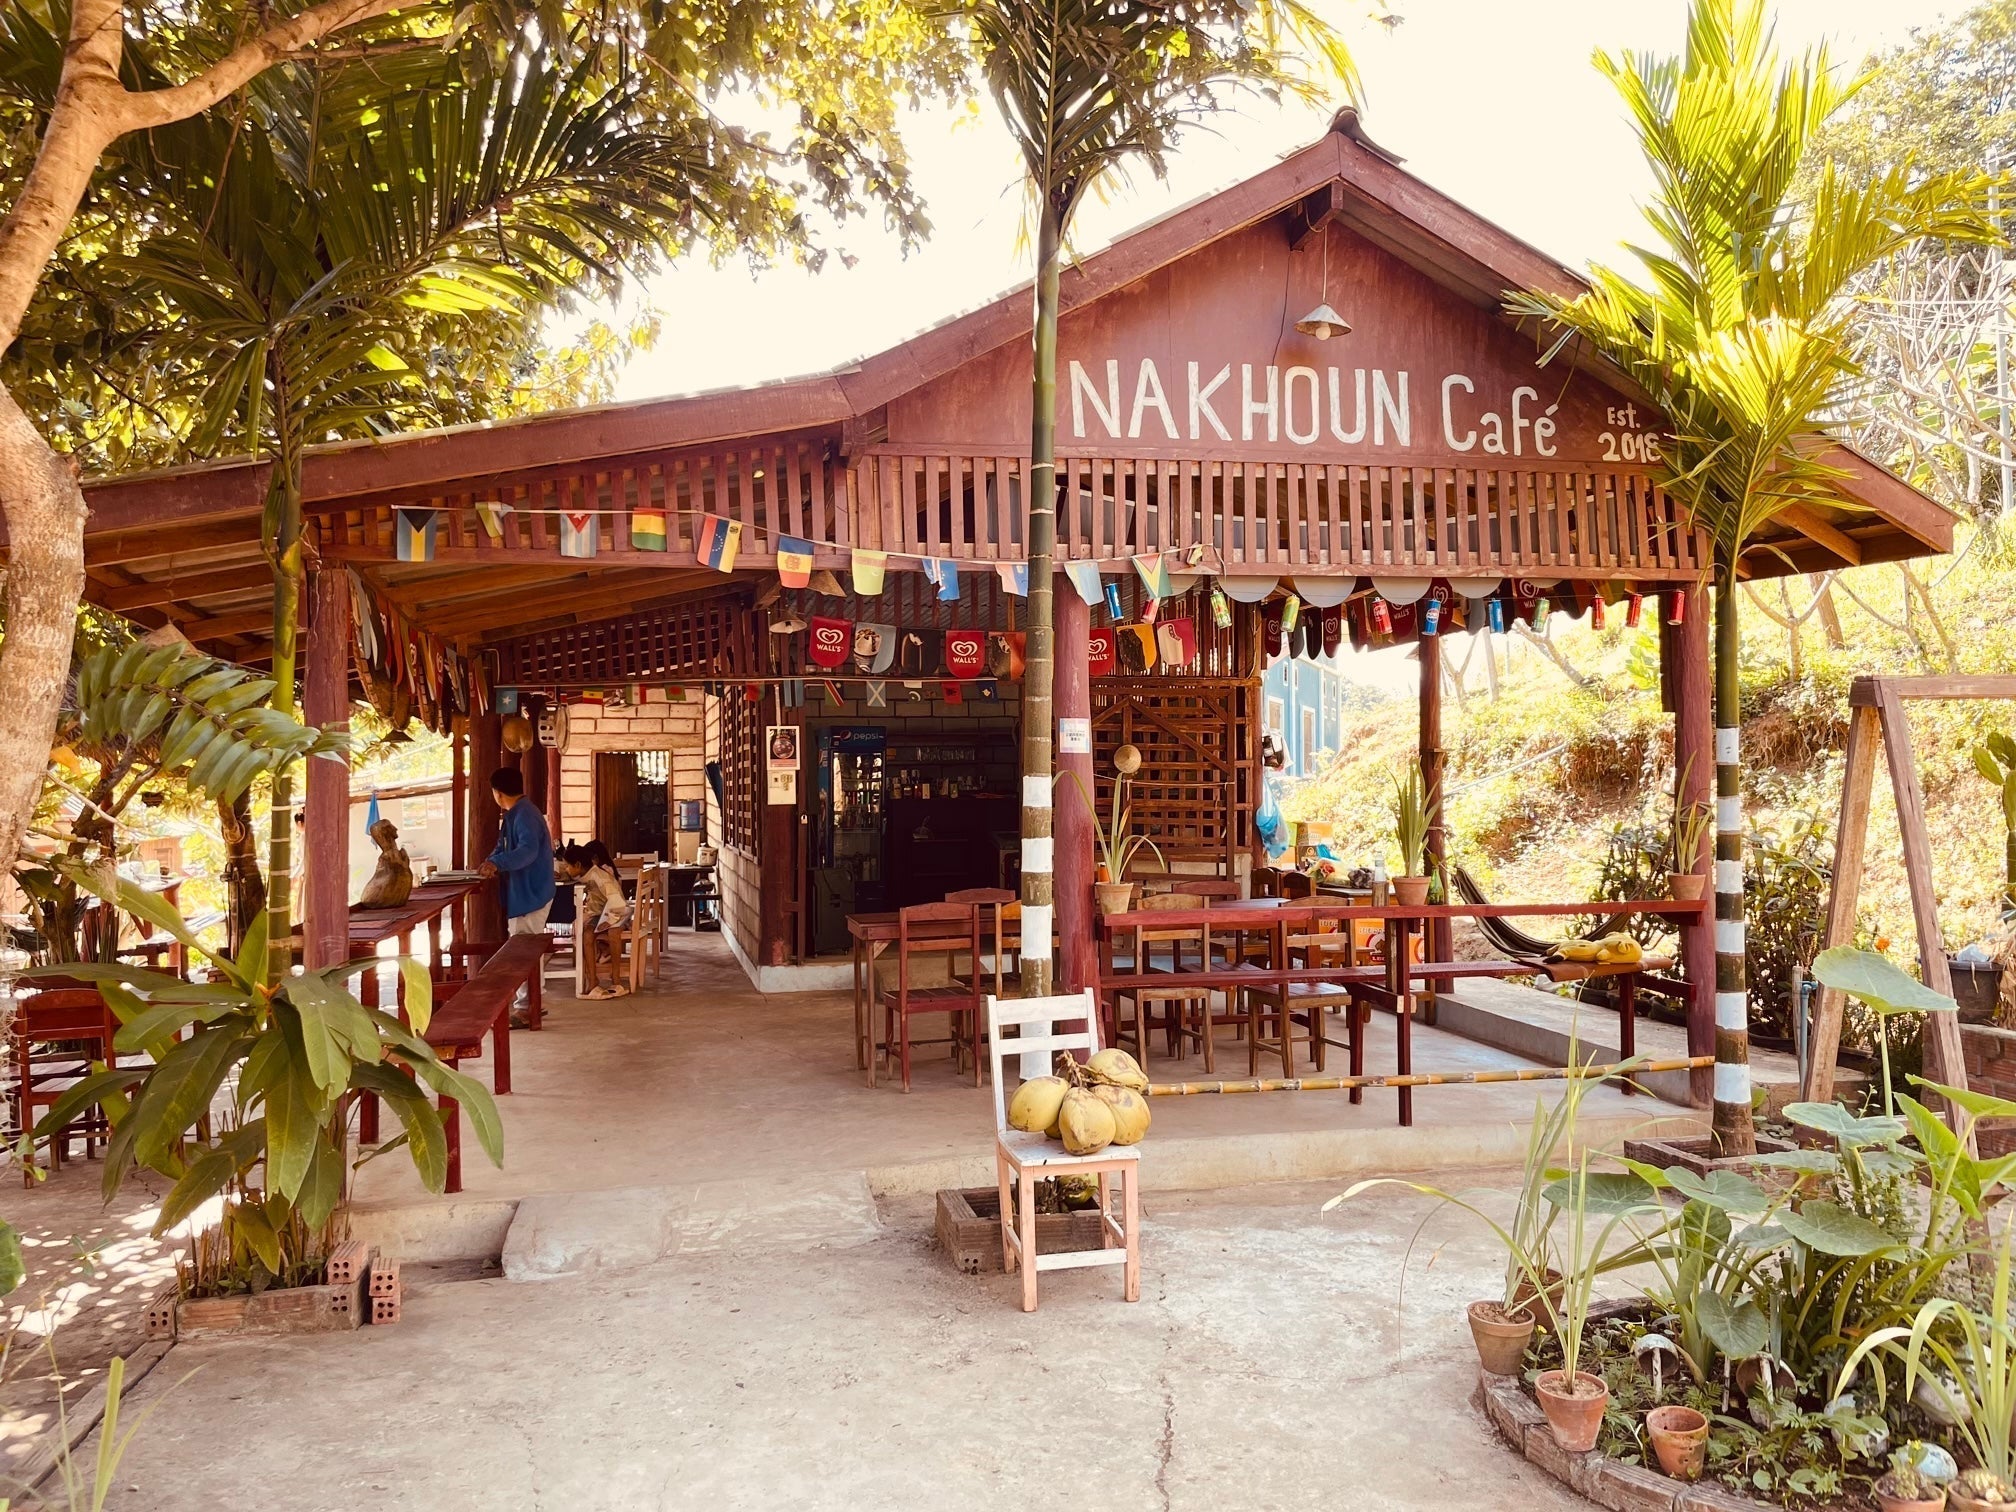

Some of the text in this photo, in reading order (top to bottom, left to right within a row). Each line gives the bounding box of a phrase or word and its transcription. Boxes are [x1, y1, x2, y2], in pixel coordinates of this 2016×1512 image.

[1069, 358, 1558, 456] NAKHOUN Café
[1607, 402, 1641, 429] Est.
[816, 643, 841, 653] WALL'S
[952, 656, 977, 664] WALL'S
[853, 732, 879, 741] pepsi
